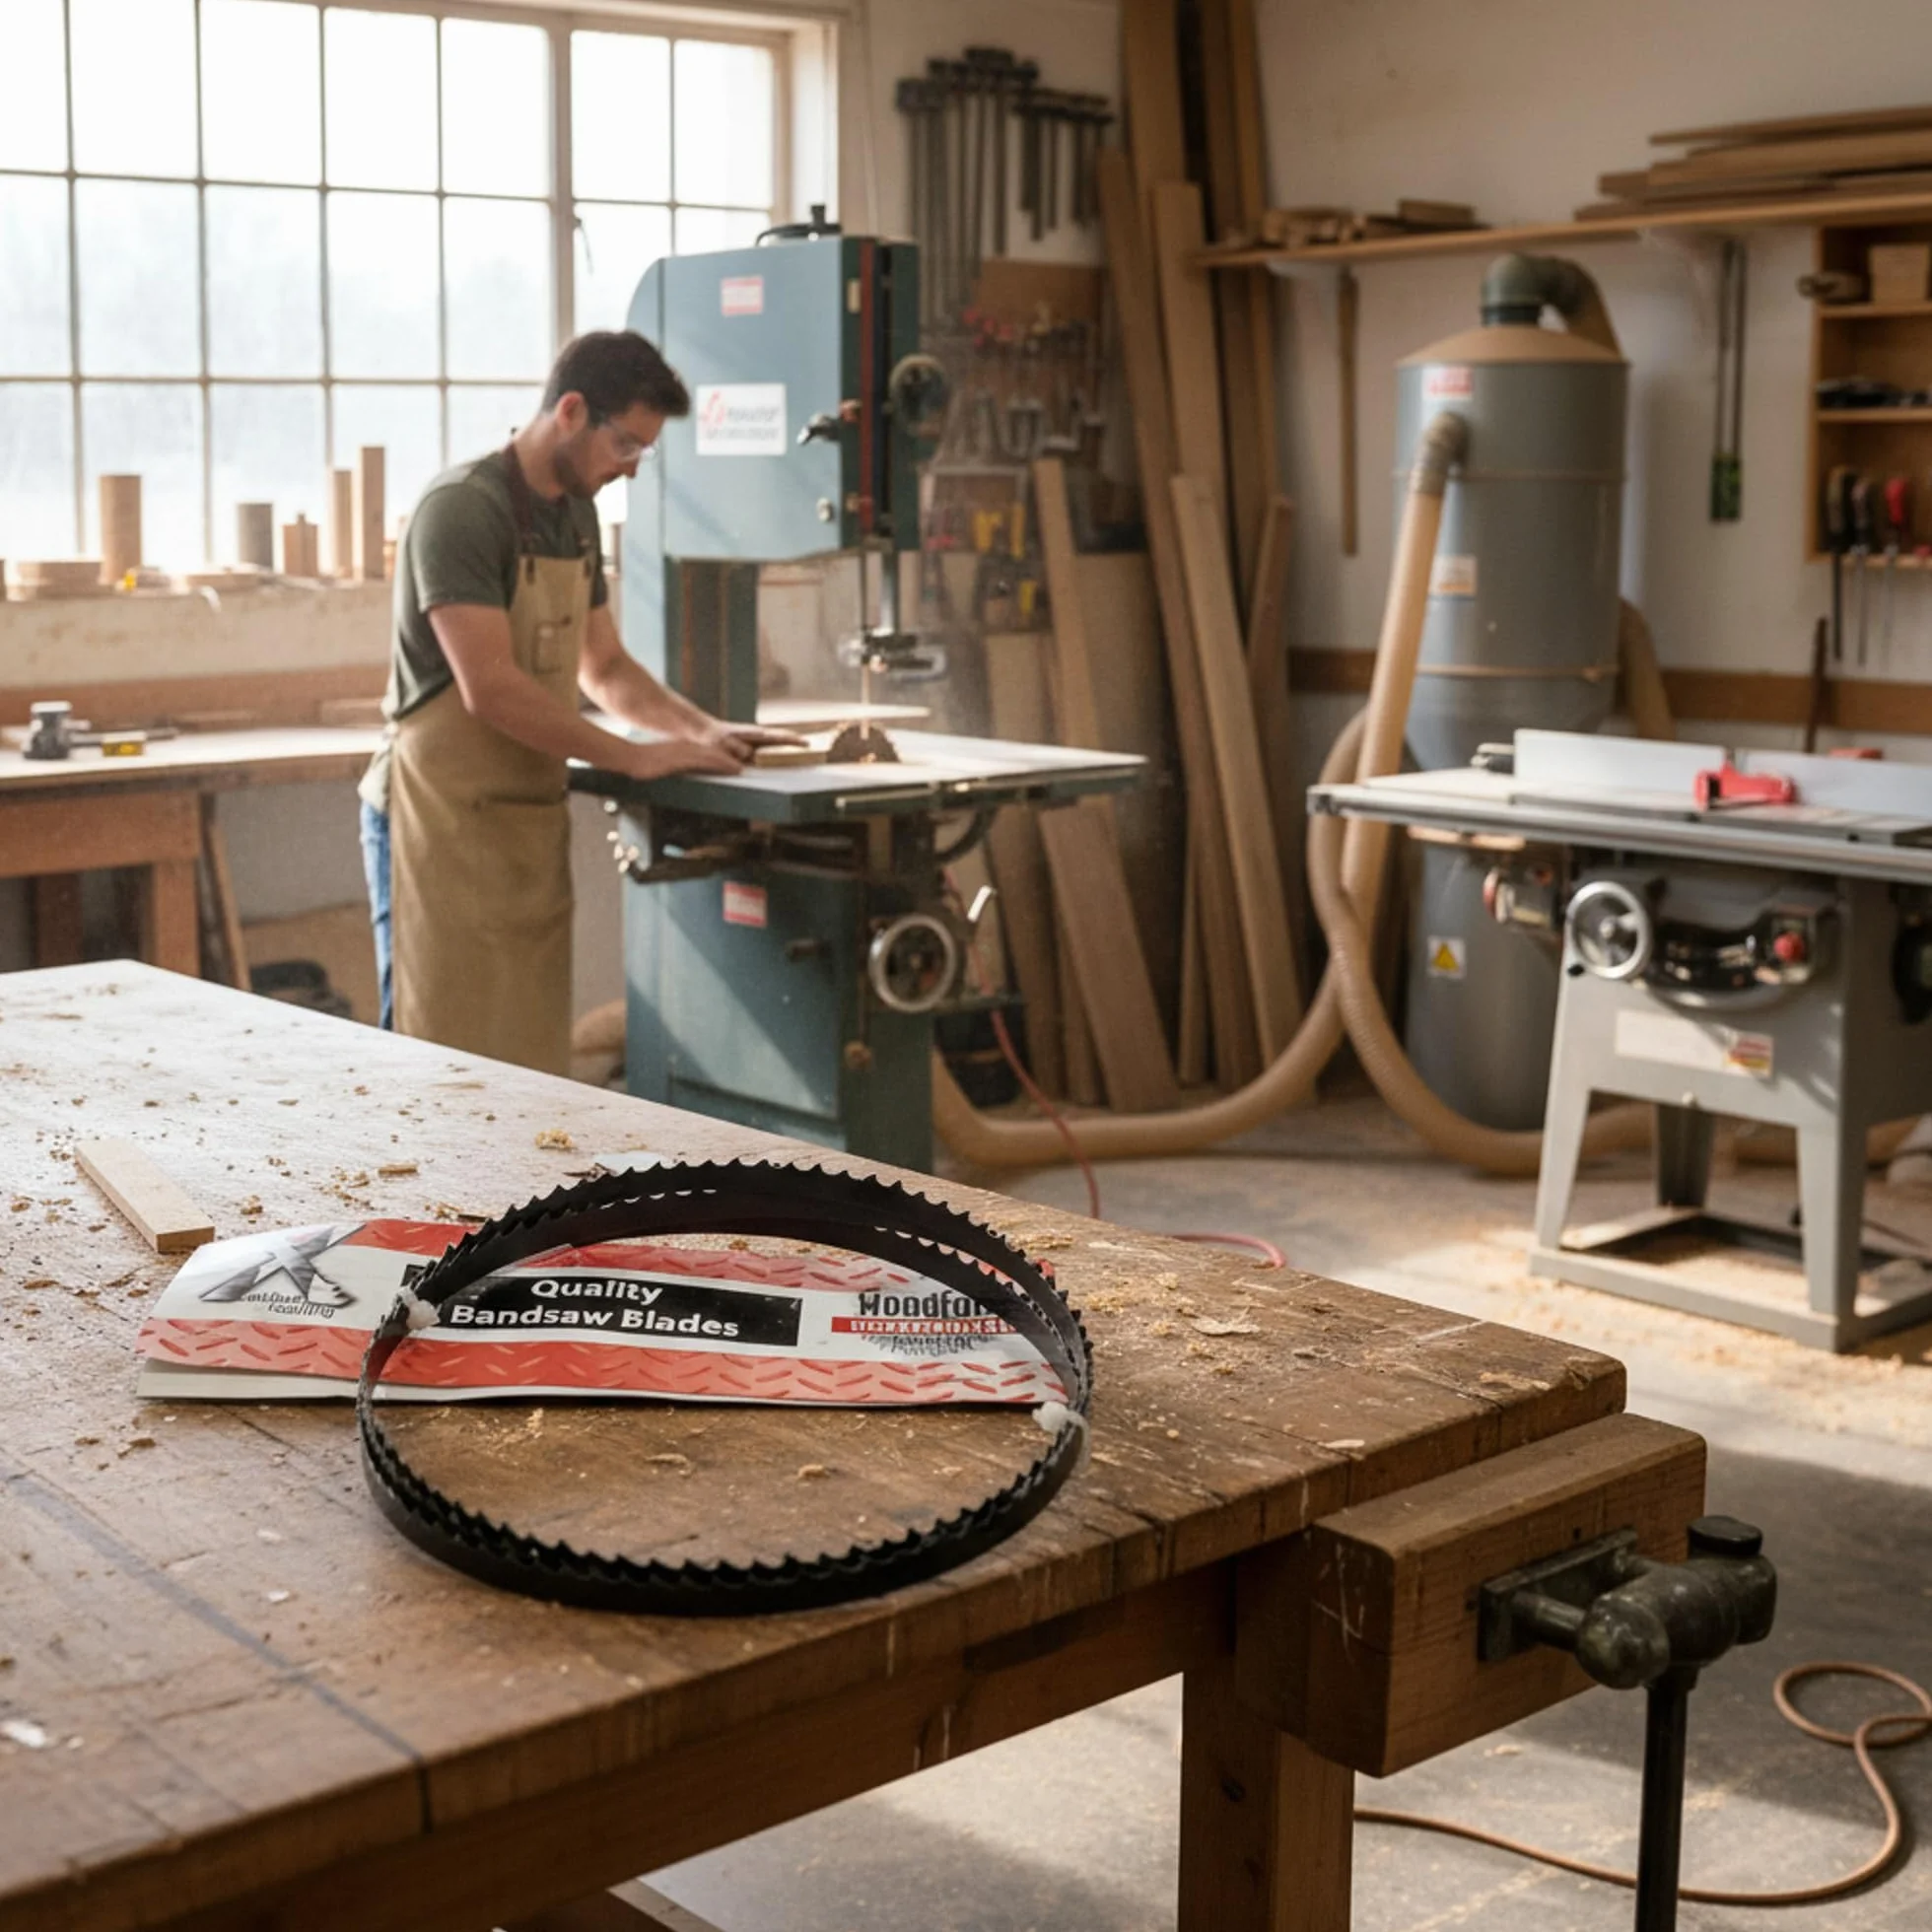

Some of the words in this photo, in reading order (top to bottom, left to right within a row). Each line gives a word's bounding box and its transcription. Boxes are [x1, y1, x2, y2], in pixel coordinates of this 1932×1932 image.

[530, 1279, 662, 1306] Quality
[449, 1304, 614, 1326] Bandsaw
[620, 1308, 739, 1337] Blades
